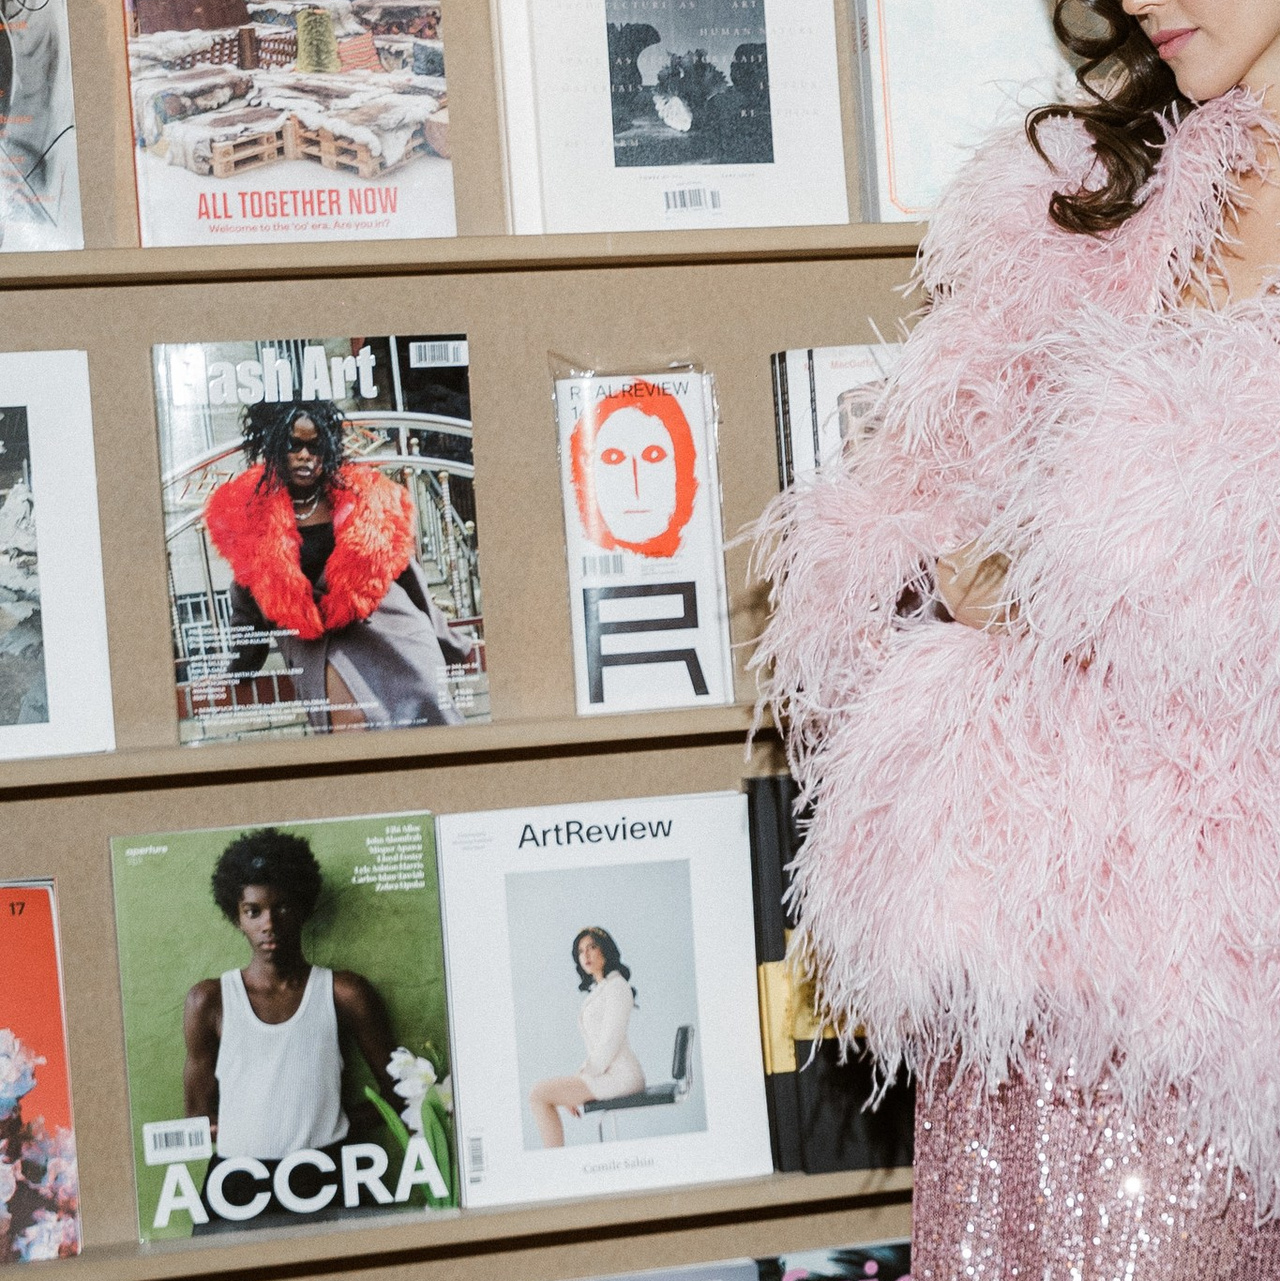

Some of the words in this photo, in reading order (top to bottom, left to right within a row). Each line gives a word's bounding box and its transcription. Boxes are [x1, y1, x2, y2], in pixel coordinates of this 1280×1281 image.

[198, 192, 232, 220] ALL
[238, 189, 342, 218] TOGETHER
[348, 186, 398, 215] NOW
[209, 224, 257, 234] Welcome
[302, 344, 378, 403] Art
[570, 385, 619, 401] RAL
[622, 381, 690, 398] REVIEW
[518, 816, 674, 850] ArtReview
[125, 845, 169, 858] aperture
[8, 901, 26, 916] 17
[153, 1135, 450, 1229] ACCRA
